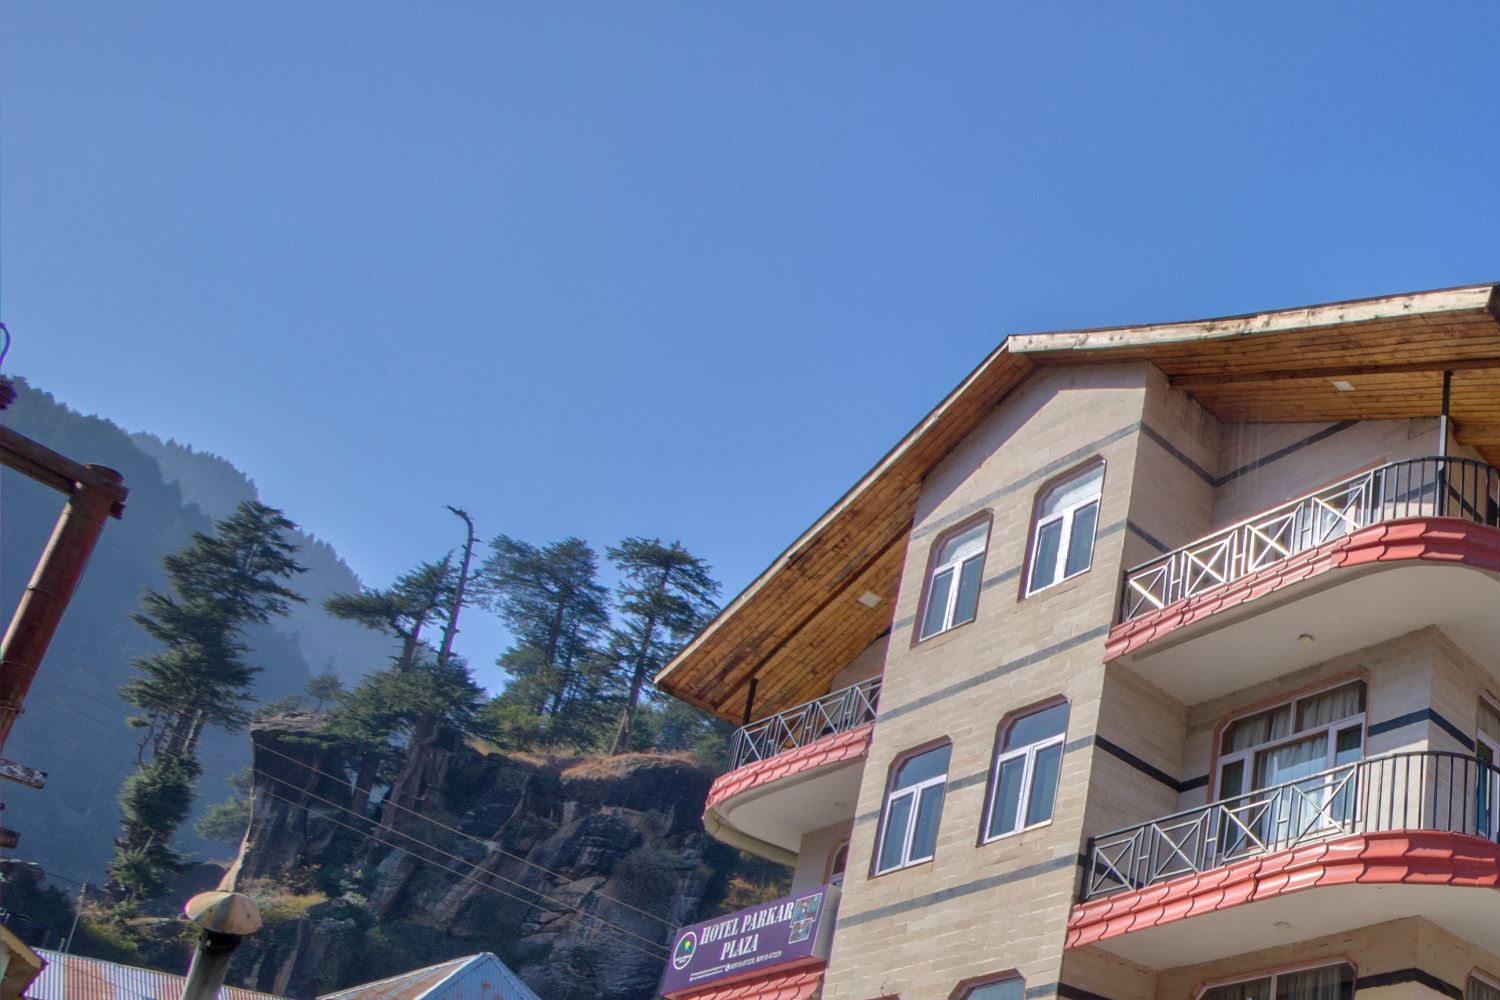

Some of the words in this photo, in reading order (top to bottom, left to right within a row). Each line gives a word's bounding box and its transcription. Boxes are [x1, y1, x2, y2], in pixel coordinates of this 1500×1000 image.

[700, 917, 739, 945] HOTEL
[740, 901, 794, 933] PARKAR
[720, 933, 759, 961] PLAZA
